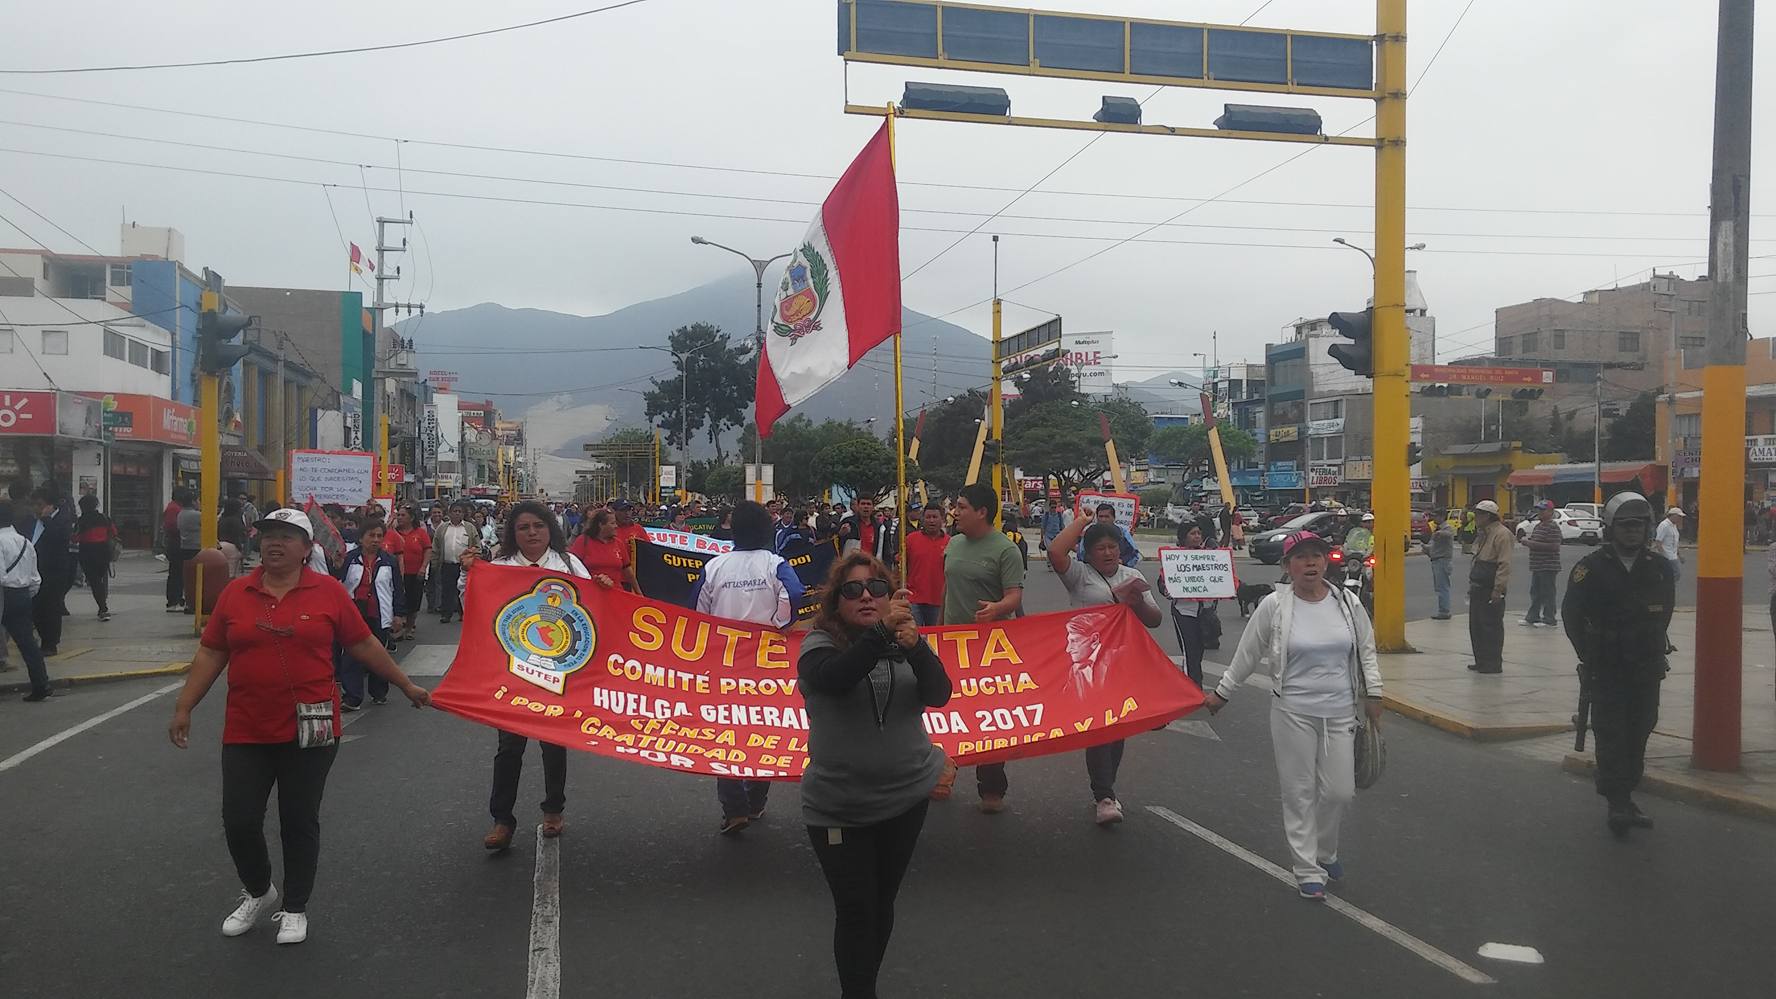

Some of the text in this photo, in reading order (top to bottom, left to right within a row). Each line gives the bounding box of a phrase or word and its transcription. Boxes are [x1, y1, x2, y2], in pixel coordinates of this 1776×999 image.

[164, 408, 188, 433] Mifarma
[352, 413, 361, 446] DENTAL
[1311, 476, 1338, 484] LIBROS
[1314, 468, 1332, 476] FERIA
[1024, 480, 1044, 488] ars
[648, 532, 731, 554] SUTE BAS
[663, 554, 703, 570] SUTEP
[1166, 554, 1180, 562] HOY
[1192, 563, 1228, 572] MAESTROS
[722, 578, 767, 590] ATUSPARIA
[1168, 574, 1182, 583] MÁS
[628, 606, 790, 669] SUTE
[516, 663, 560, 684] SUTEP
[607, 653, 710, 694] COMITÉ
[720, 678, 798, 696] PROV
[593, 688, 693, 719] HUELGA
[922, 712, 970, 734] IDA
[976, 703, 1044, 732] 2017
[511, 695, 564, 718] POR
[747, 732, 782, 750] DE
[1105, 696, 1139, 726] LA
[580, 716, 793, 768] GRATUIDAD DE
